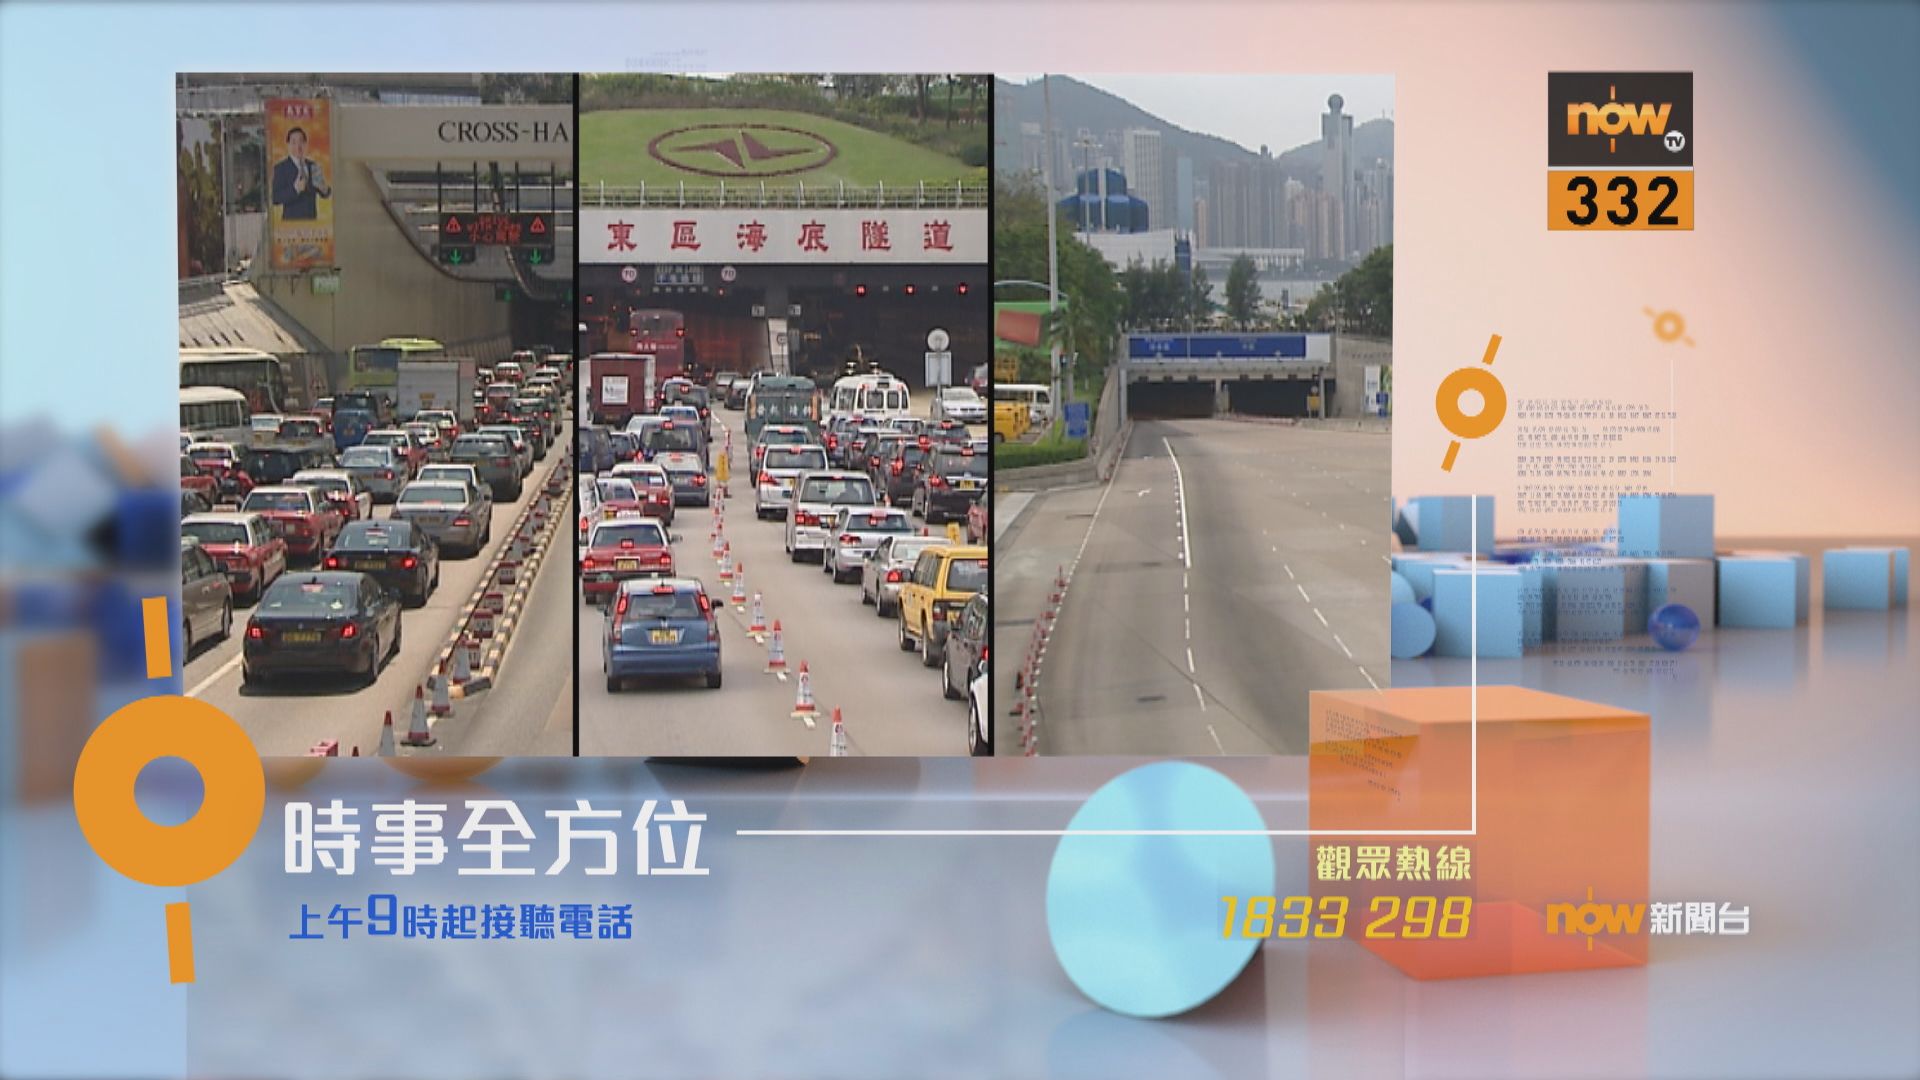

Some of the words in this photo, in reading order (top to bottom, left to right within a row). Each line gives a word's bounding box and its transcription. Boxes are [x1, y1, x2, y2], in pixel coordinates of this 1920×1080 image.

[438, 121, 569, 143] CROSS-HA
[607, 220, 953, 251] 東區海底隧道
